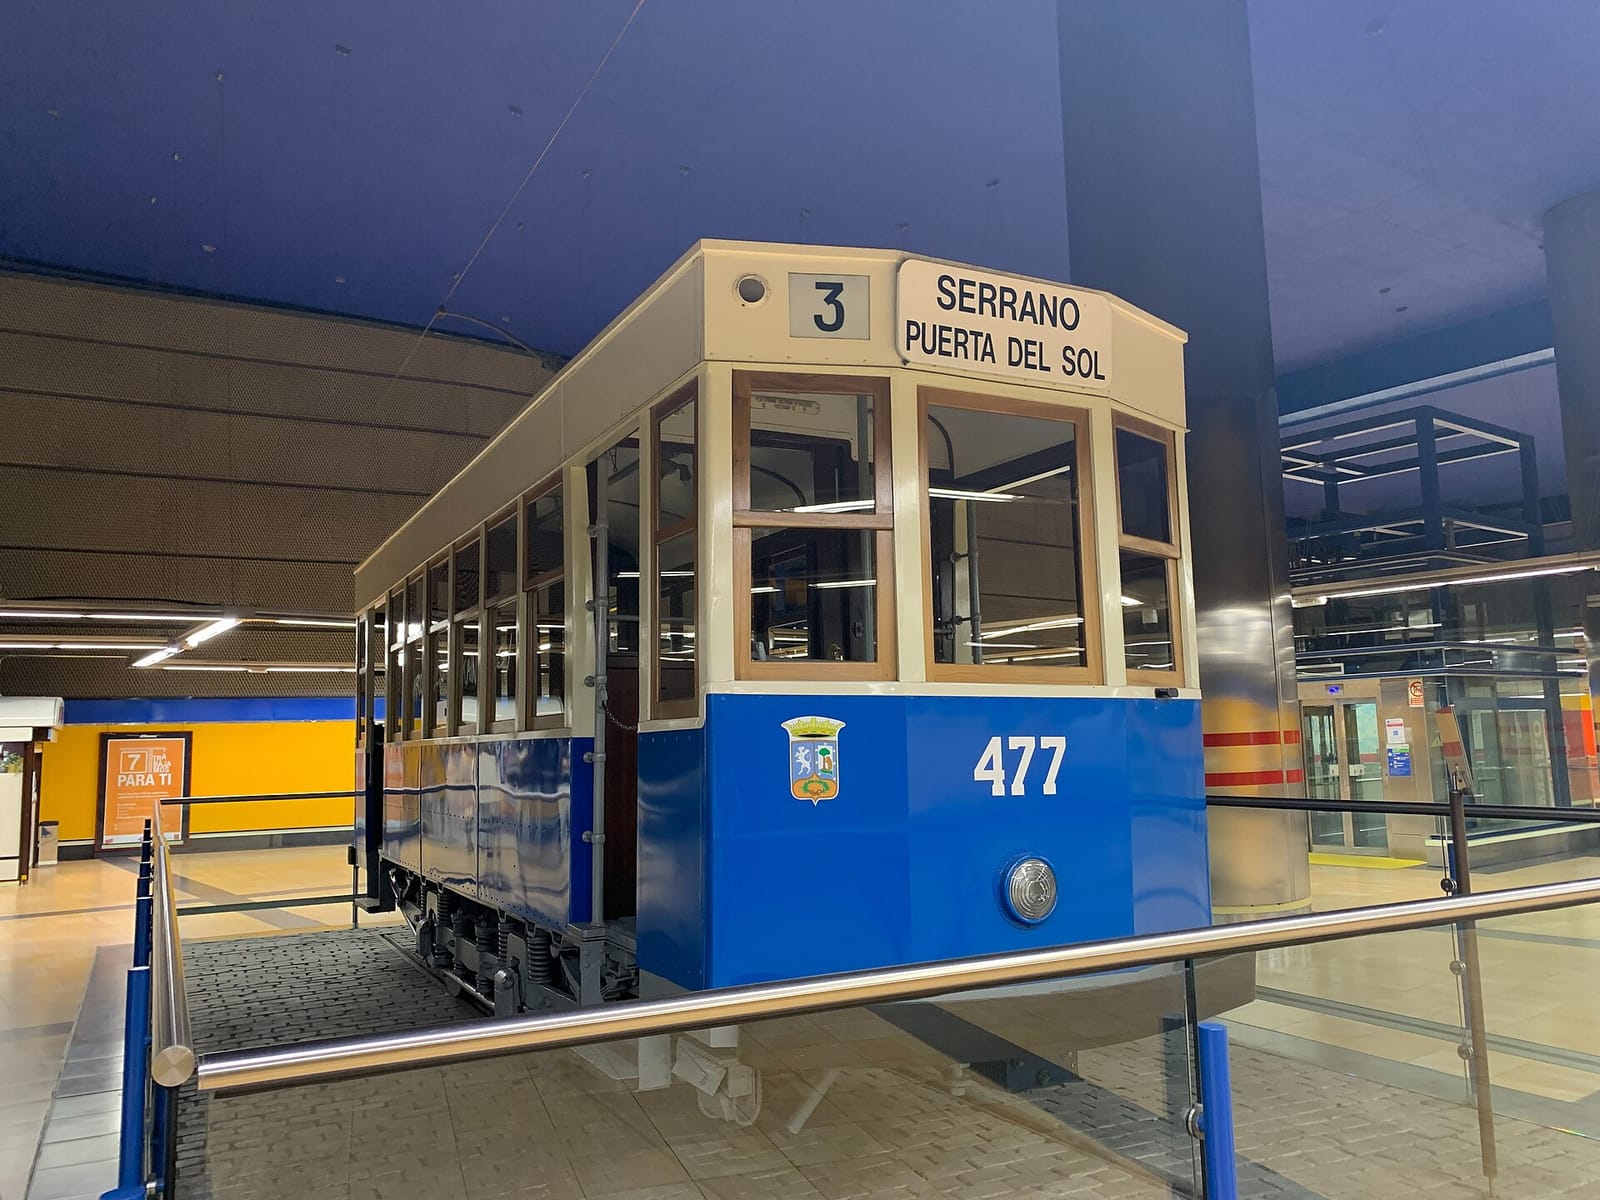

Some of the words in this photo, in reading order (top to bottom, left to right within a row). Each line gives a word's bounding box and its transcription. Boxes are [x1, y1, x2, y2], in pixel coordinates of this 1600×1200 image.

[813, 281, 845, 332] 3
[936, 274, 1080, 331] SERRANO
[906, 319, 996, 363] PUERTA
[1007, 336, 1051, 372] DEL
[1061, 345, 1106, 381] SOL
[117, 774, 155, 787] PARA
[159, 773, 172, 786] TI
[127, 754, 141, 771] 7
[973, 736, 1067, 796] 477
